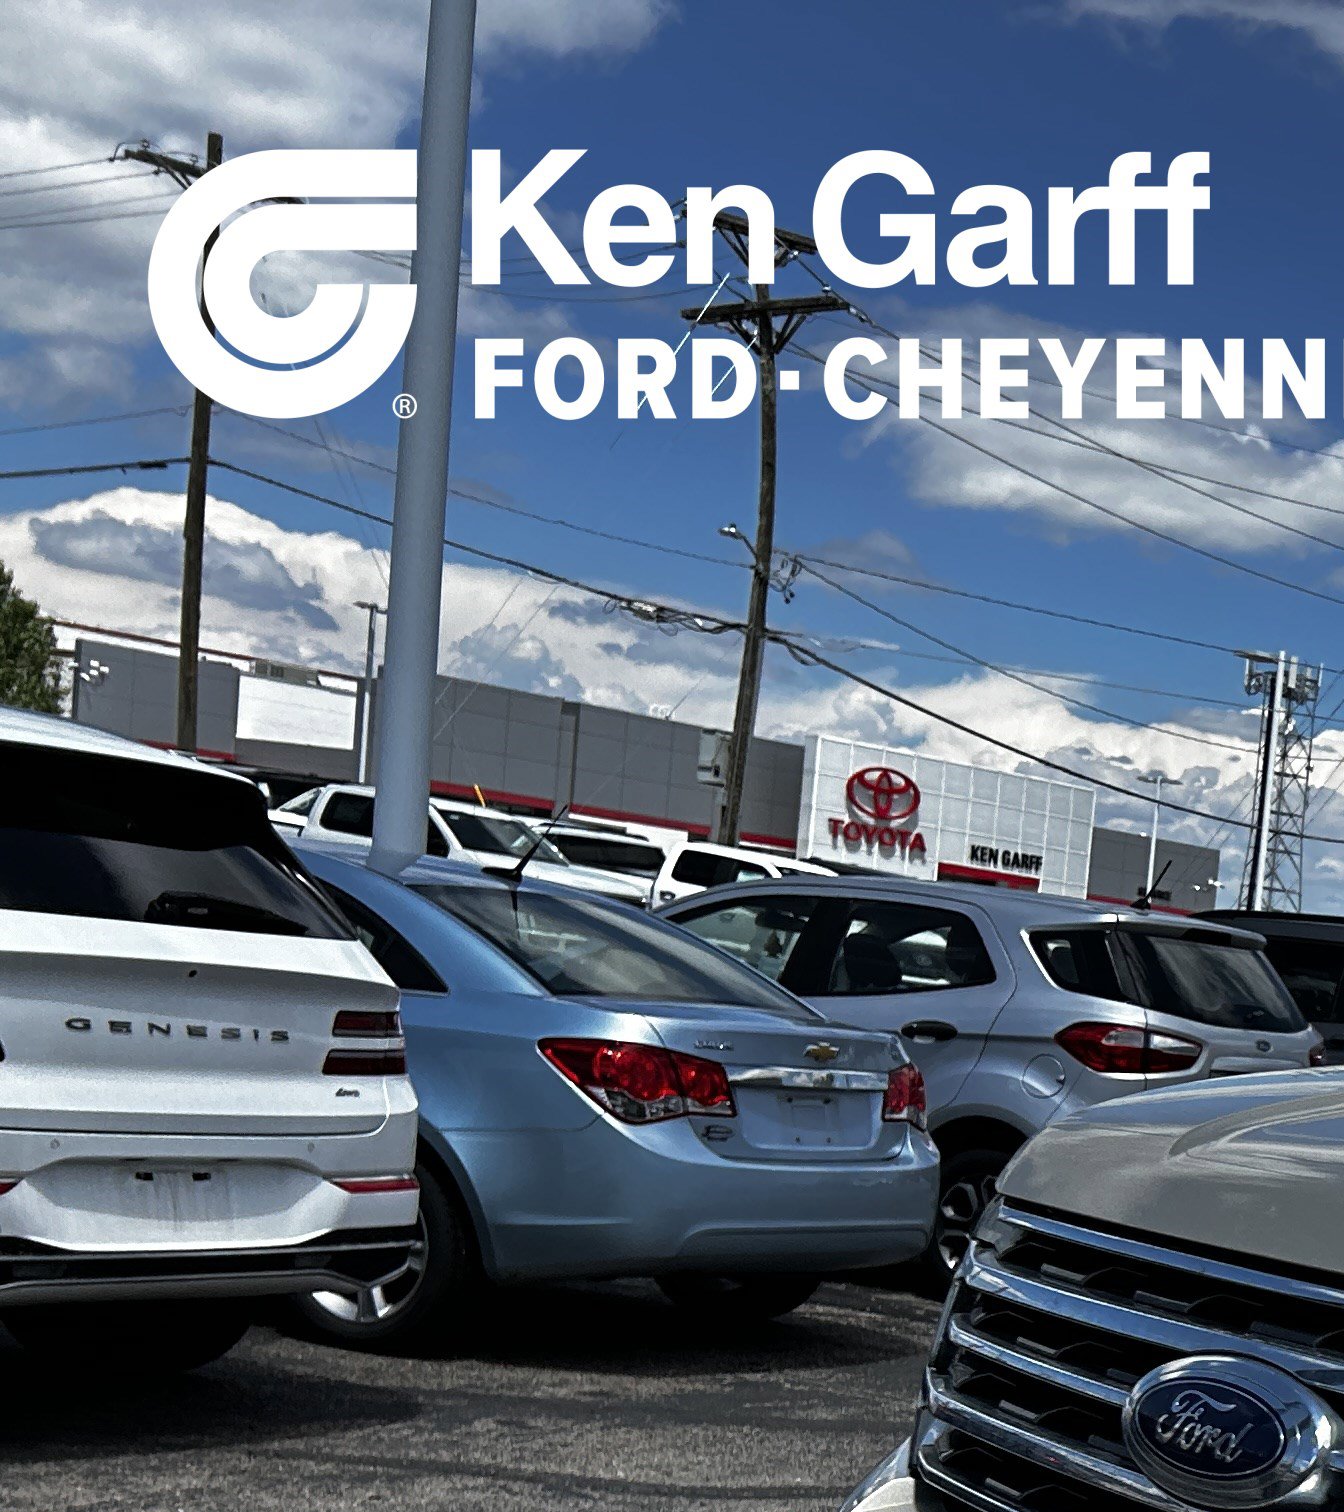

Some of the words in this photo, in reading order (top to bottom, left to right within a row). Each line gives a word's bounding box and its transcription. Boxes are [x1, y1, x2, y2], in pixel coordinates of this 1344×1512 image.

[828, 818, 927, 852] TOYOTA
[970, 844, 999, 868] KEN
[1001, 850, 1044, 872] GARFF
[64, 1016, 290, 1042] GENESIS
[1156, 1388, 1255, 1463] Ford
